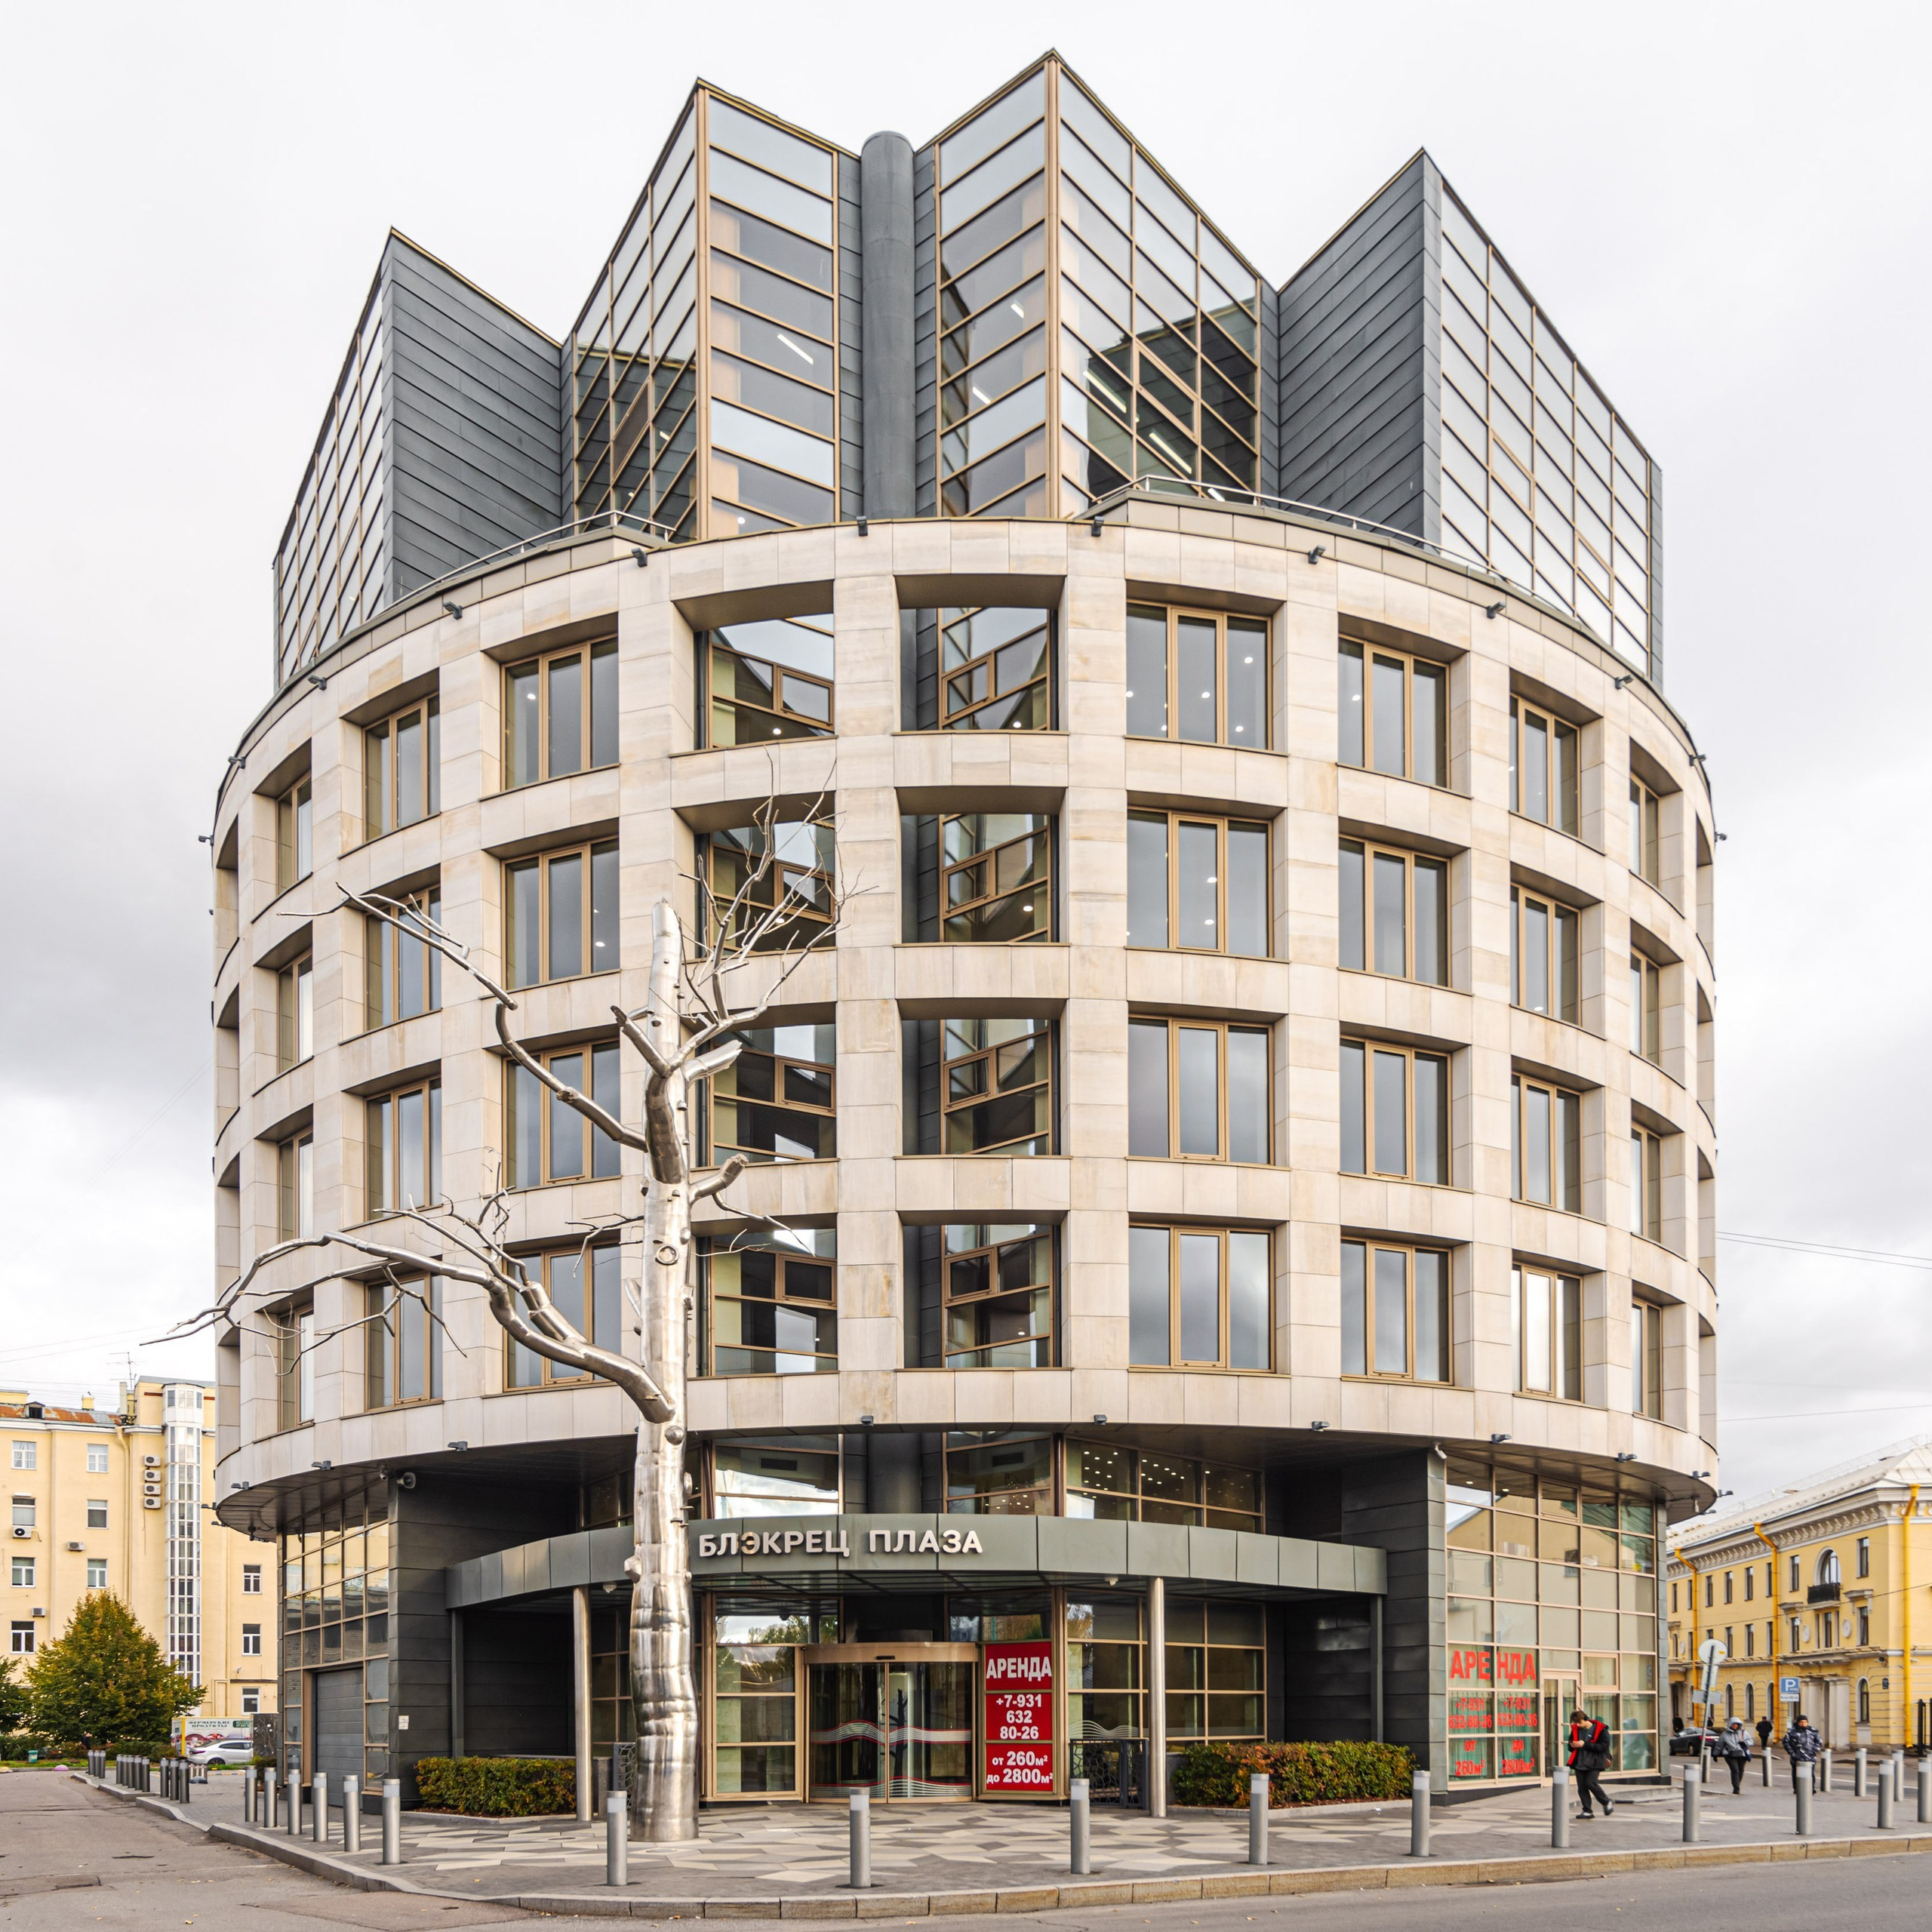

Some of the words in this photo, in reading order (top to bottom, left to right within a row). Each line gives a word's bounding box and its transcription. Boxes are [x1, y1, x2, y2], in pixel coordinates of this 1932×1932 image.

[699, 1530, 850, 1557] БЛЭКРЕЦ
[869, 1529, 983, 1553] ПЛАЗА
[986, 1657, 1053, 1681] АРЕНДА
[1450, 1650, 1537, 1685] АРЕНДА
[995, 1694, 1041, 1708] +7-931
[1456, 1697, 1485, 1712] +7-931
[1503, 1697, 1531, 1711] +7-931
[1006, 1710, 1032, 1724] 632
[1448, 1714, 1493, 1729] 632-80-26
[1497, 1712, 1538, 1727] 632-80-26
[1000, 1726, 1039, 1740] 80-26
[992, 1757, 1004, 1766] от
[986, 1774, 1000, 1784] до
